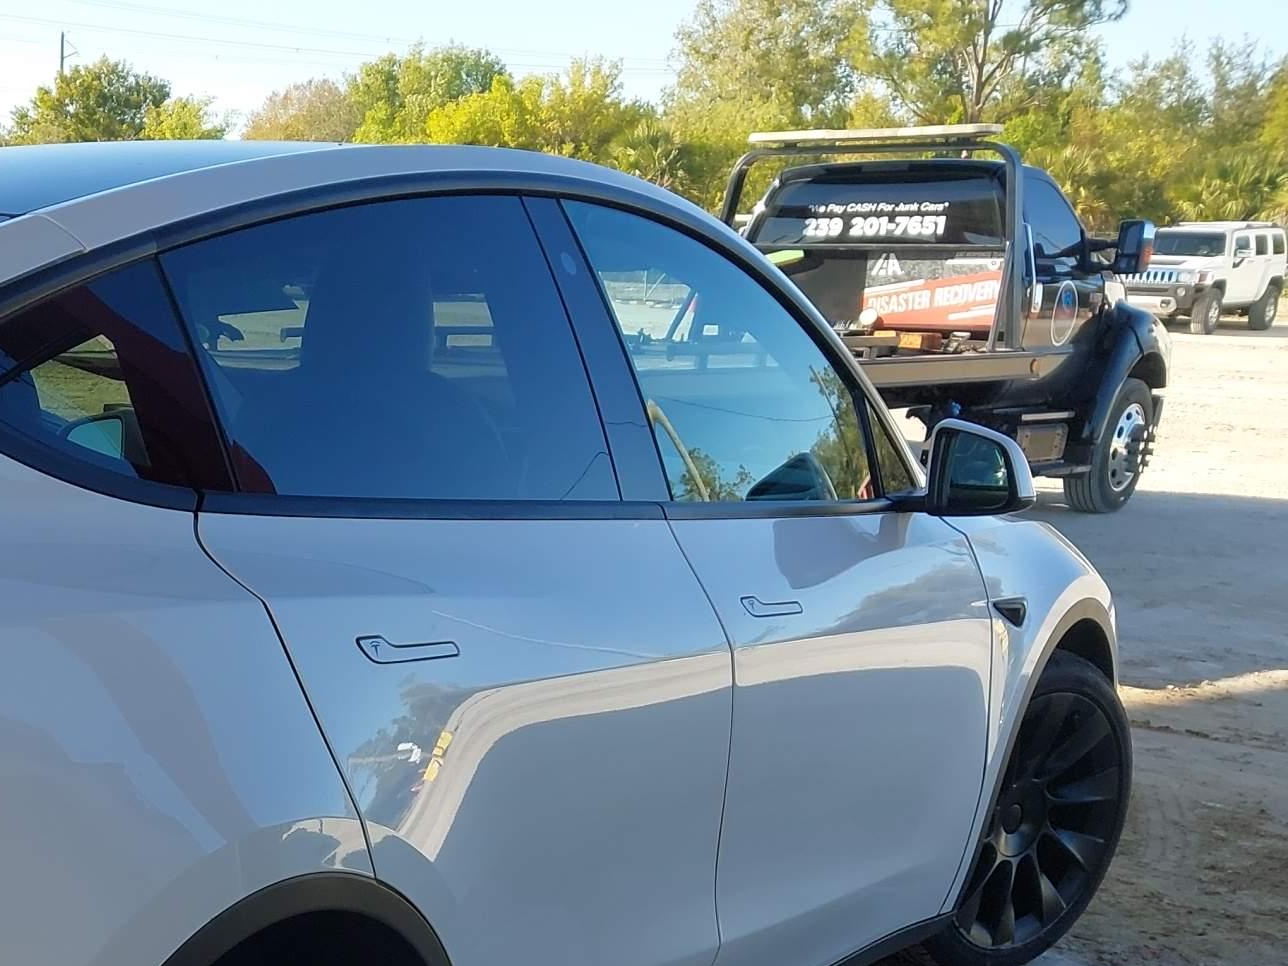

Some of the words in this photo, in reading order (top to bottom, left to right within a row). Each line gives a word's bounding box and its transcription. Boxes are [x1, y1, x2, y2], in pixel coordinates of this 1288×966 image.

[827, 203, 846, 214] Pay
[847, 203, 877, 212] CASH
[877, 203, 895, 211] For
[895, 202, 919, 211] Junk
[803, 217, 843, 236] 239
[849, 215, 947, 236] 201-7651
[868, 291, 931, 314] DISASTER
[934, 279, 1000, 307] RECOVERY
